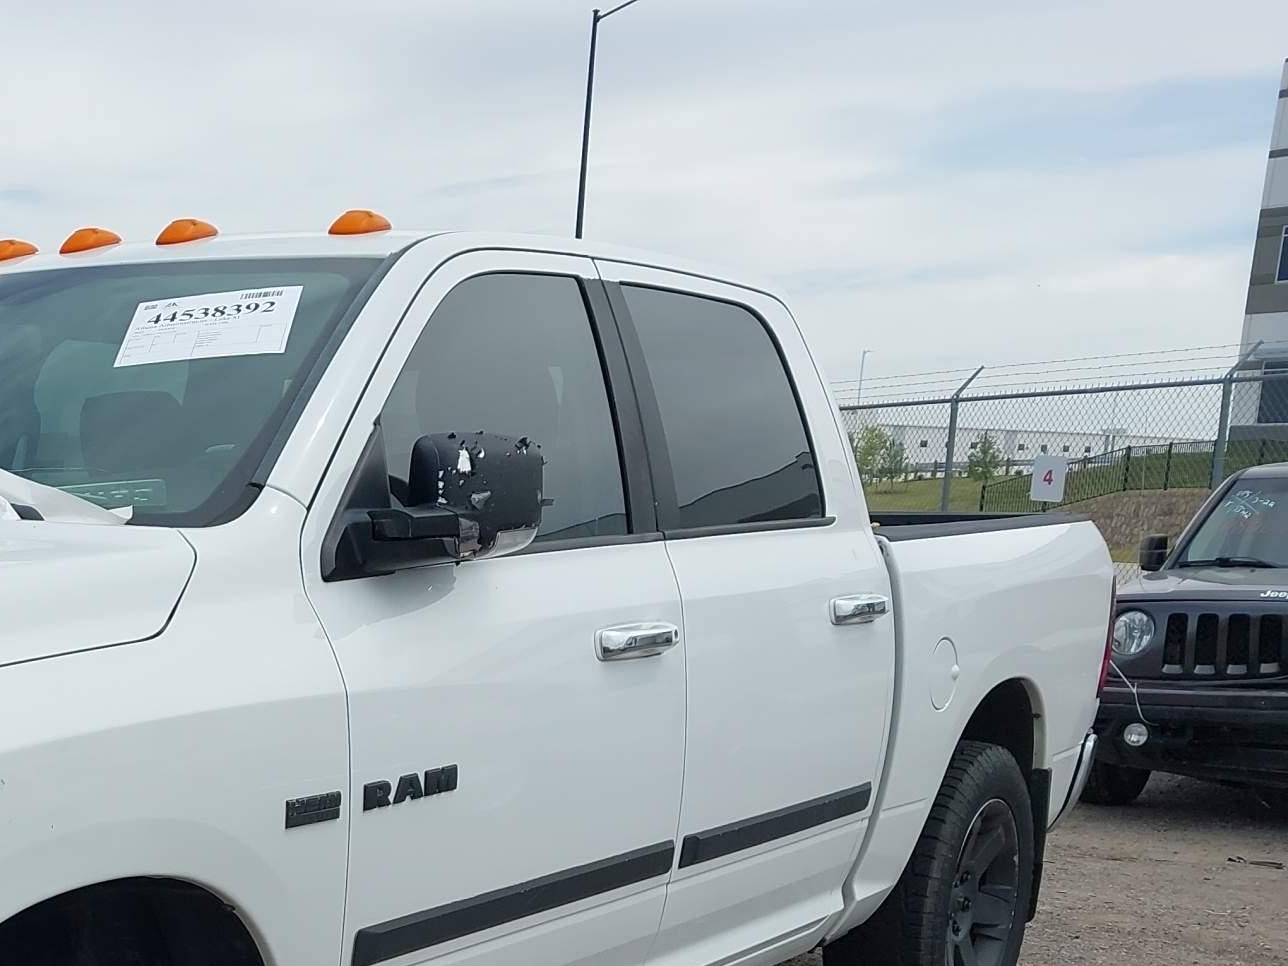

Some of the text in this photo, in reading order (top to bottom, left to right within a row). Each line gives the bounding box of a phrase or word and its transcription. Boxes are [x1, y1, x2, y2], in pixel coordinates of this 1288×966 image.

[146, 300, 276, 325] 44538392
[1042, 469, 1054, 486] 4
[362, 763, 458, 812] RAM
